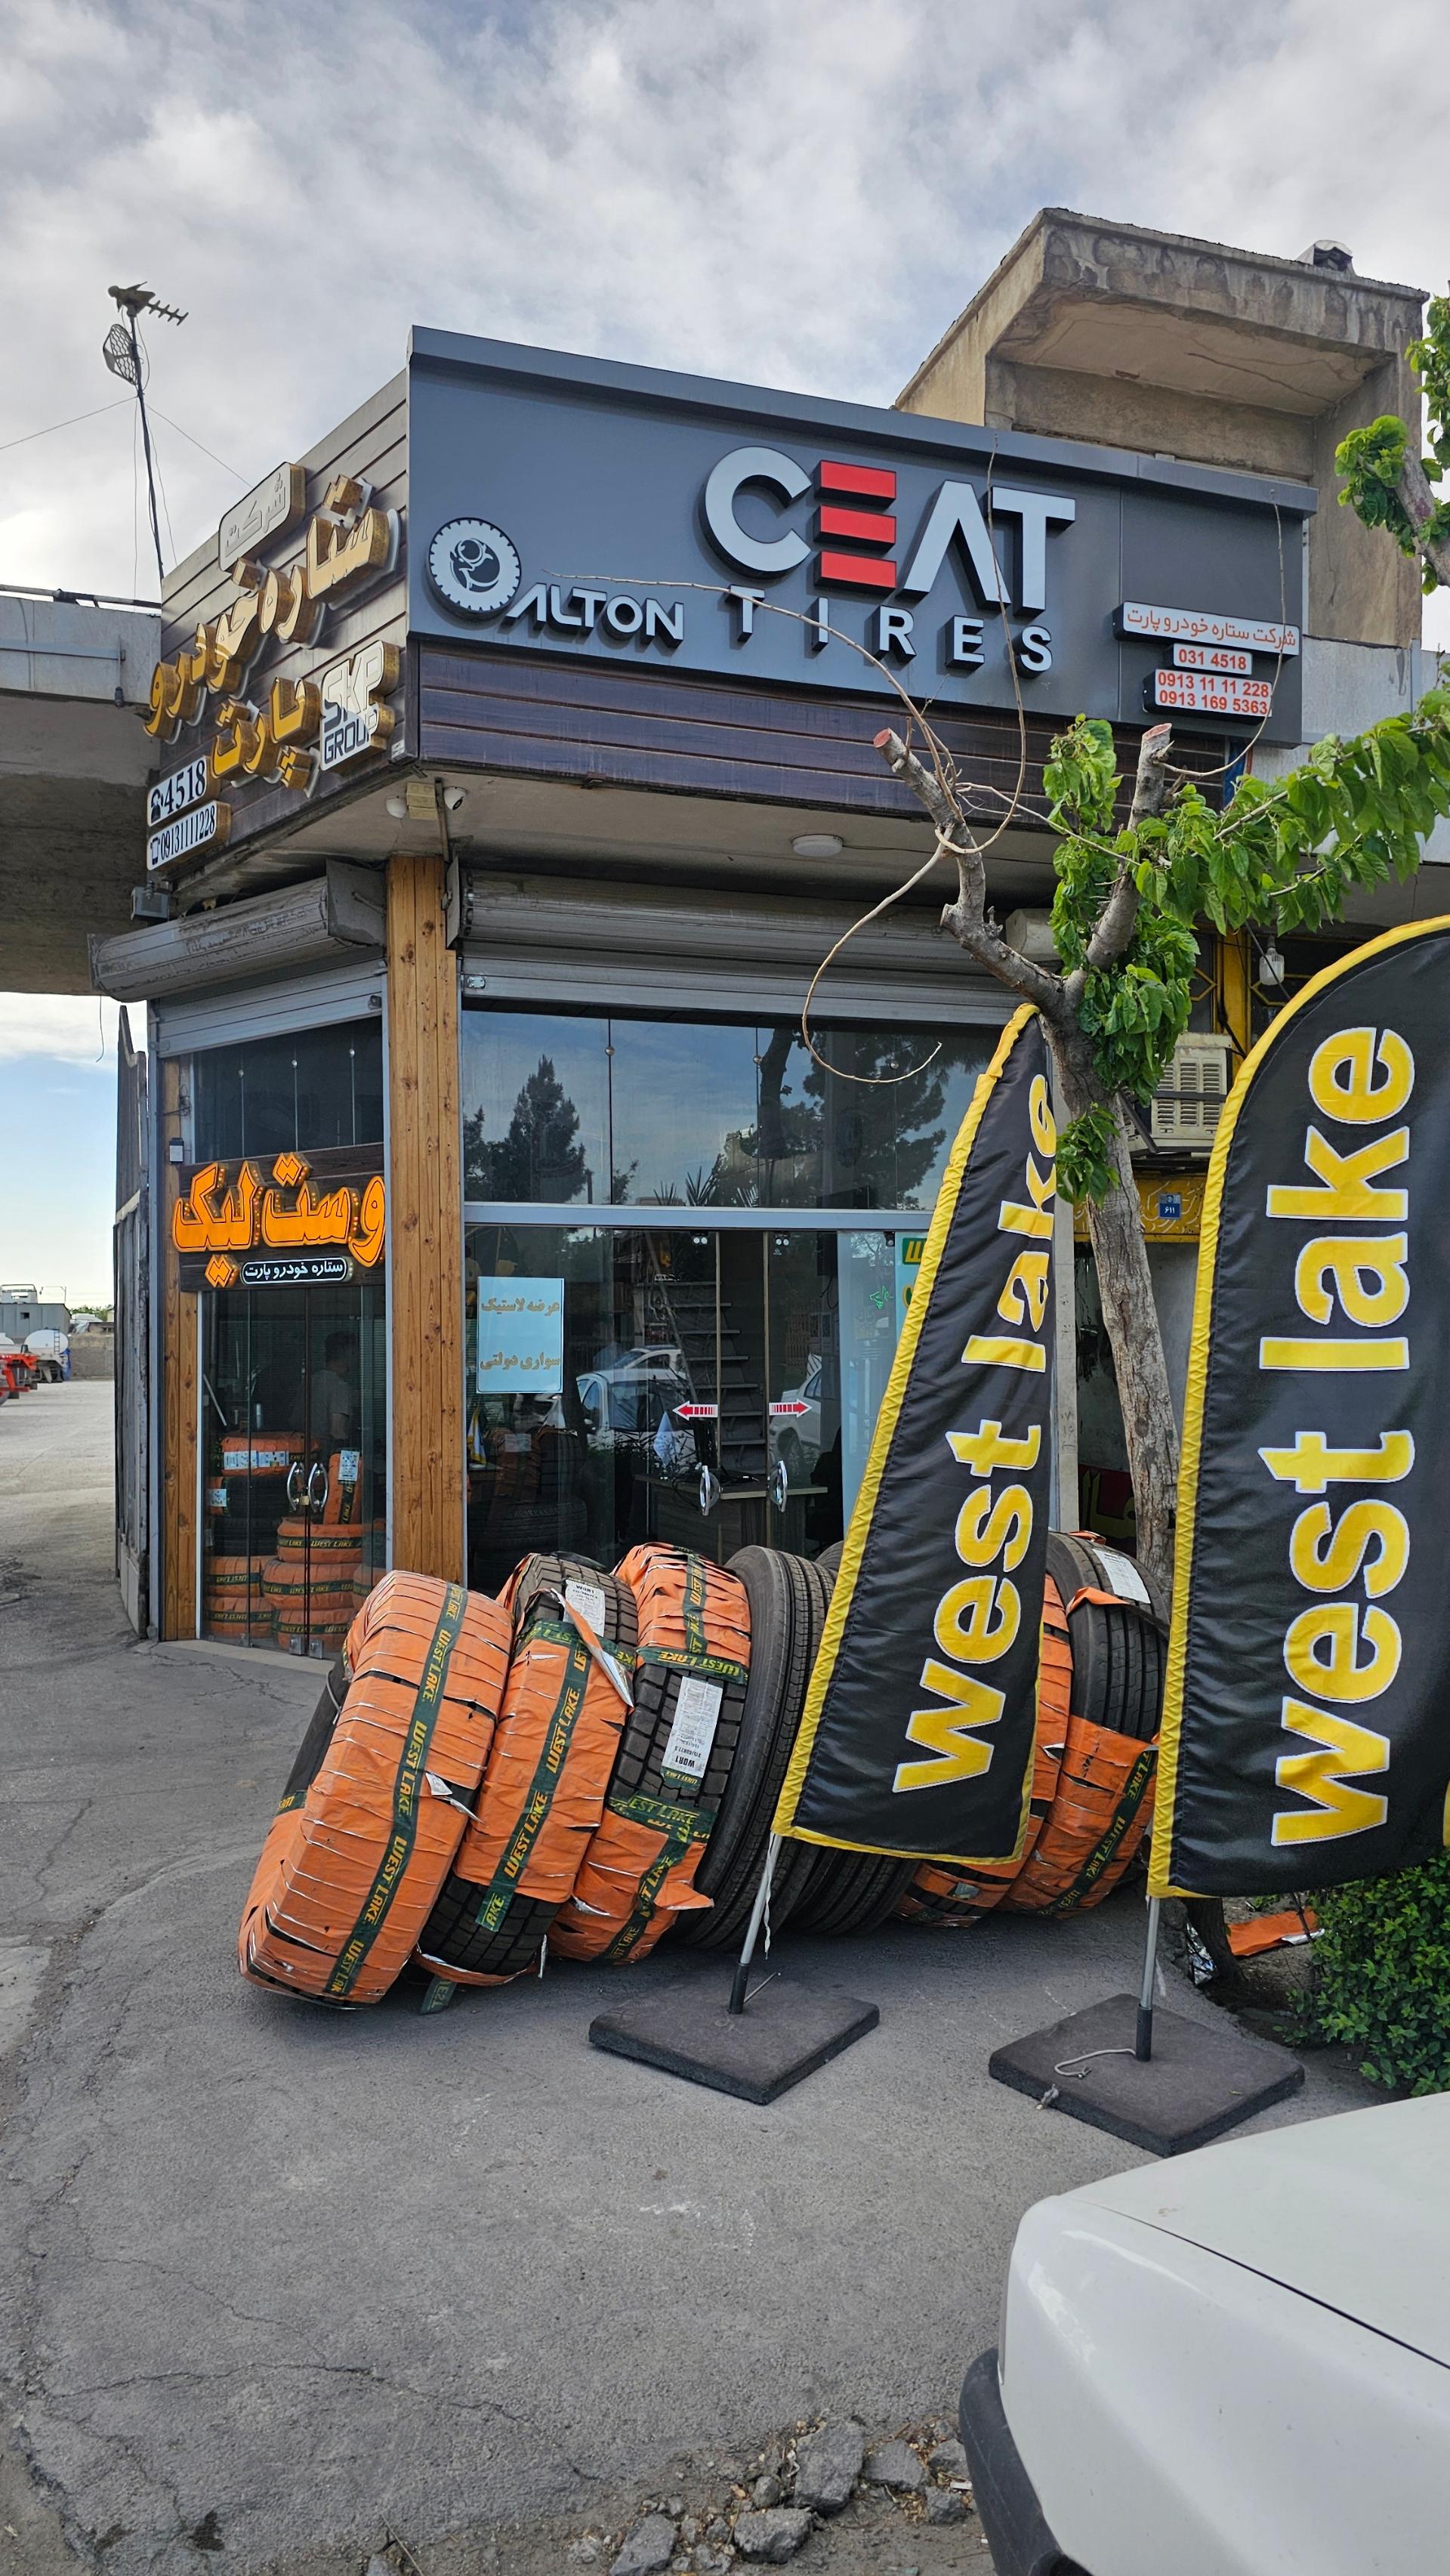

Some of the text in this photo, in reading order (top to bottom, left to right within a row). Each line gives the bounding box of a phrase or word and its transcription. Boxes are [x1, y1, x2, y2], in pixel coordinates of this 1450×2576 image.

[226, 471, 288, 547] شرکت
[703, 445, 1075, 615] CEAT
[143, 474, 390, 743] ستاره خودرو
[505, 582, 684, 647] ALTON
[729, 585, 1052, 676] TIRES
[1127, 610, 1296, 649] شرکت ستاره خودرو پارت
[1158, 672, 1269, 698] 0913 11 11 228
[1178, 648, 1246, 670] 031 4518
[1159, 690, 1268, 715] 0913 169 5363
[211, 676, 319, 790] پارت
[165, 760, 205, 814] 4518
[161, 805, 215, 860] 09131111228
[262, 1151, 386, 1268] وست
[245, 1261, 343, 1280] ستاره خودرو پارت
[481, 1297, 560, 1316] عرضه لاستیک
[480, 1351, 560, 1370] سواری دولتی
[891, 1073, 1057, 1793] west lake
[1257, 1027, 1415, 1846] west lake
[422, 1629, 452, 1703] WEST LAKE
[658, 1651, 740, 1676] WEST LAKE
[545, 1686, 581, 1774] WEST LAKE
[398, 1720, 427, 1817] WEST LAKE
[1126, 1761, 1149, 1802] LAKE
[504, 1790, 548, 1879] WEST LAKE
[628, 1797, 659, 1814] EST
[657, 1805, 698, 1825] LAKE
[1101, 1815, 1126, 1854] WEST
[363, 1836, 408, 1926] WEST LAKE
[486, 1893, 505, 1928] AKE
[330, 1938, 365, 1994] WEST LAK
